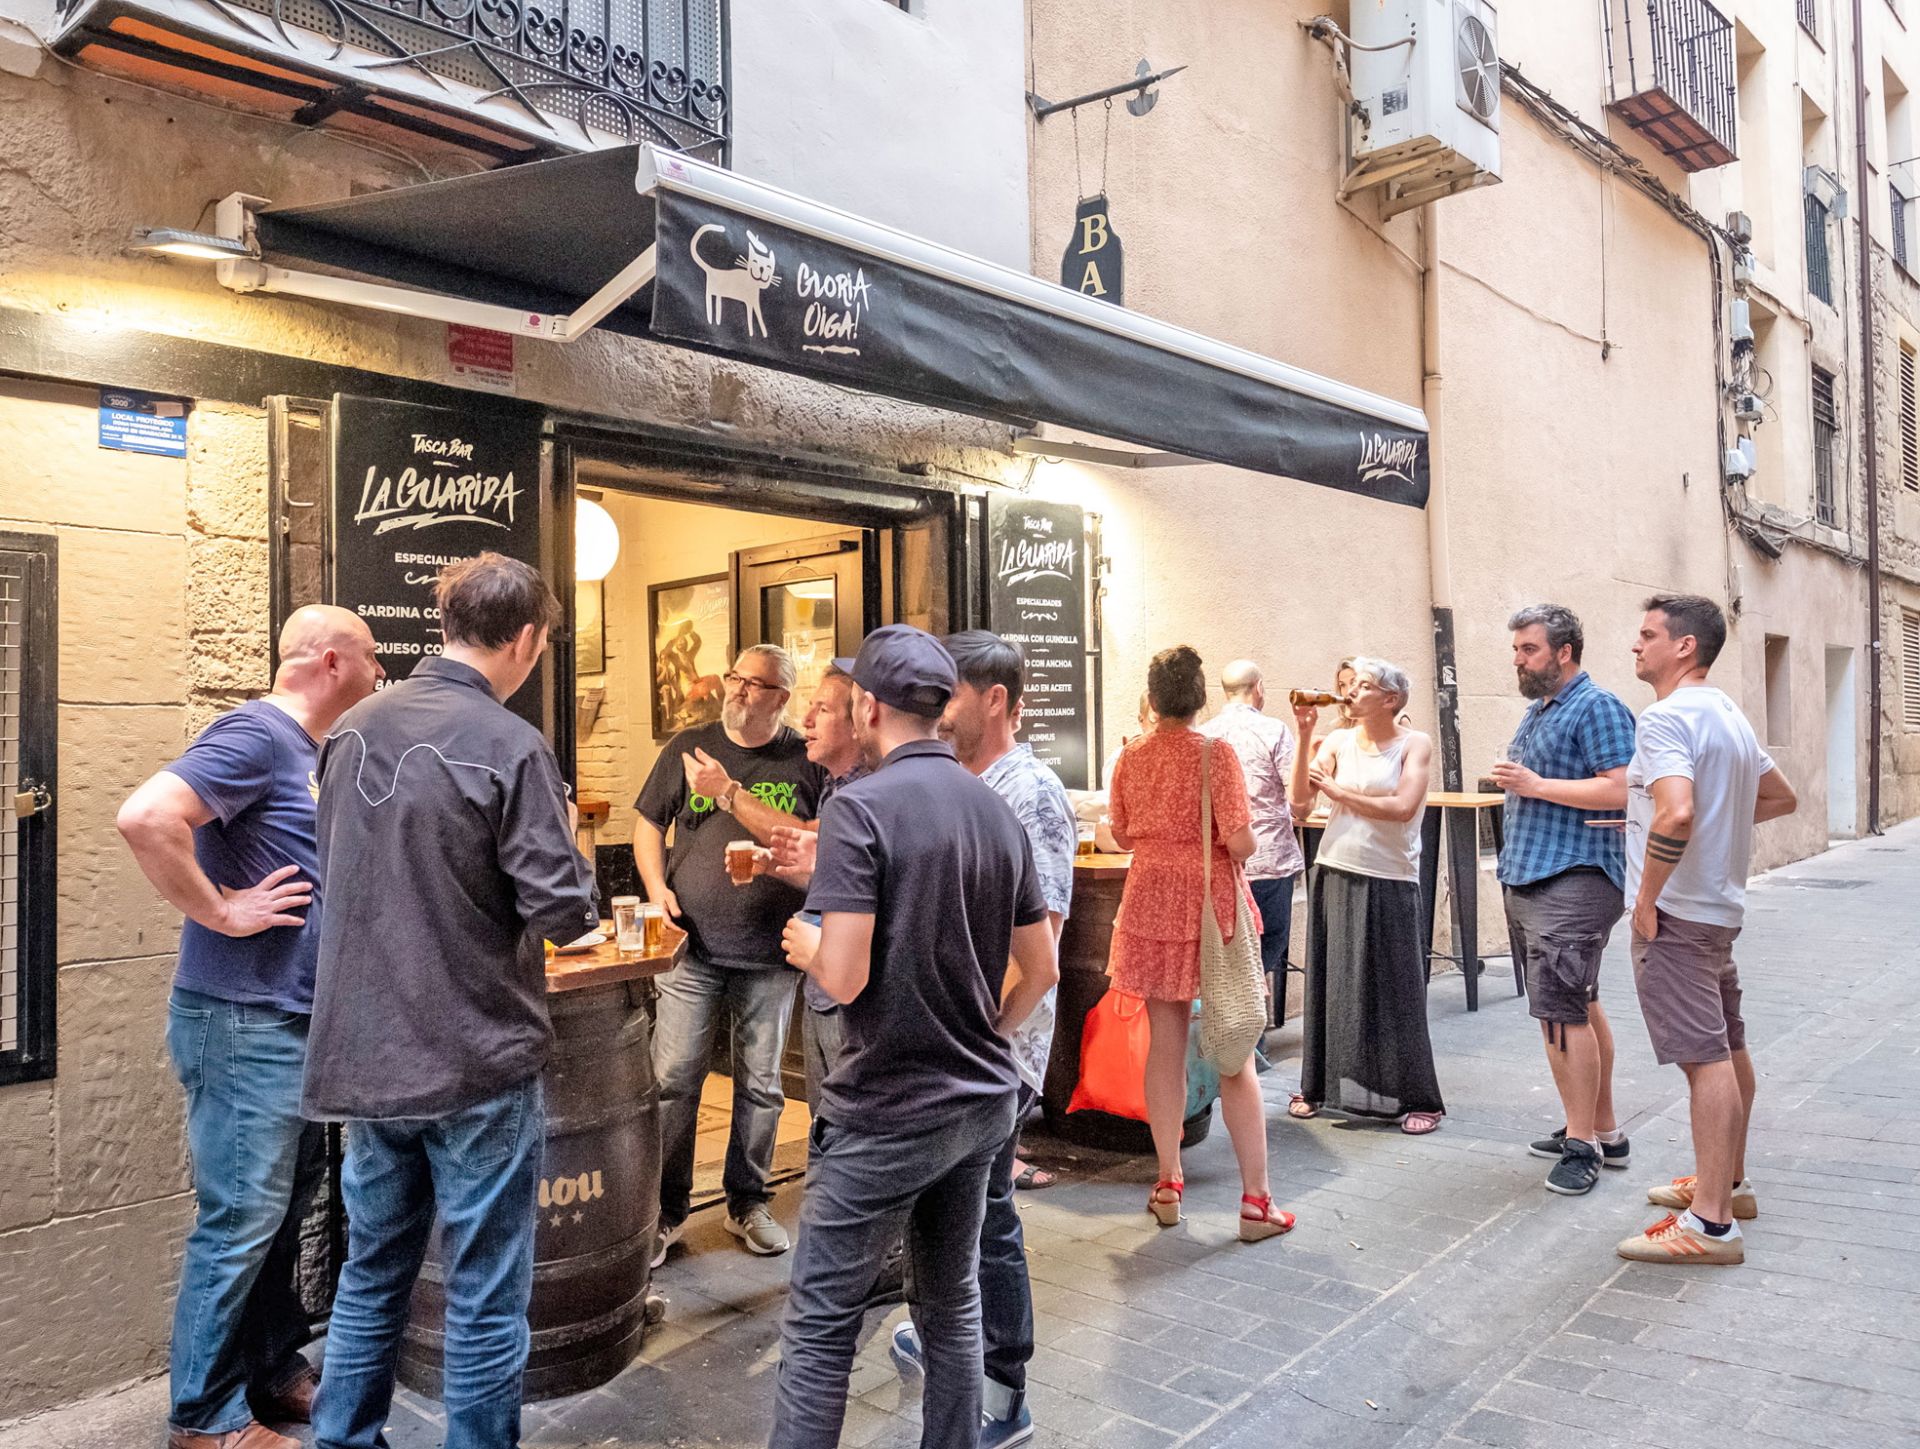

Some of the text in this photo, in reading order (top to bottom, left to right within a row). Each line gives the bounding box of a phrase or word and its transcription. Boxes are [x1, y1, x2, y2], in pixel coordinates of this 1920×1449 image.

[1078, 213, 1108, 297] BA
[111, 412, 135, 422] LOCAL
[354, 465, 525, 526] LA GUARIDA
[1016, 597, 1062, 608] ESPECIALIDADES
[357, 604, 441, 619] SARDINA CO
[1000, 633, 1079, 645] SARDINA CON GUINDILLA
[374, 642, 443, 655] QUESO CO
[1031, 659, 1045, 668] CON
[1045, 659, 1073, 668] ANCHOA
[1023, 683, 1073, 692] ALAO EN ACEITE
[1020, 707, 1076, 717] UTIDOS RIOJANOS
[1028, 733, 1056, 742] HUMMUS
[750, 781, 798, 798] SDAY
